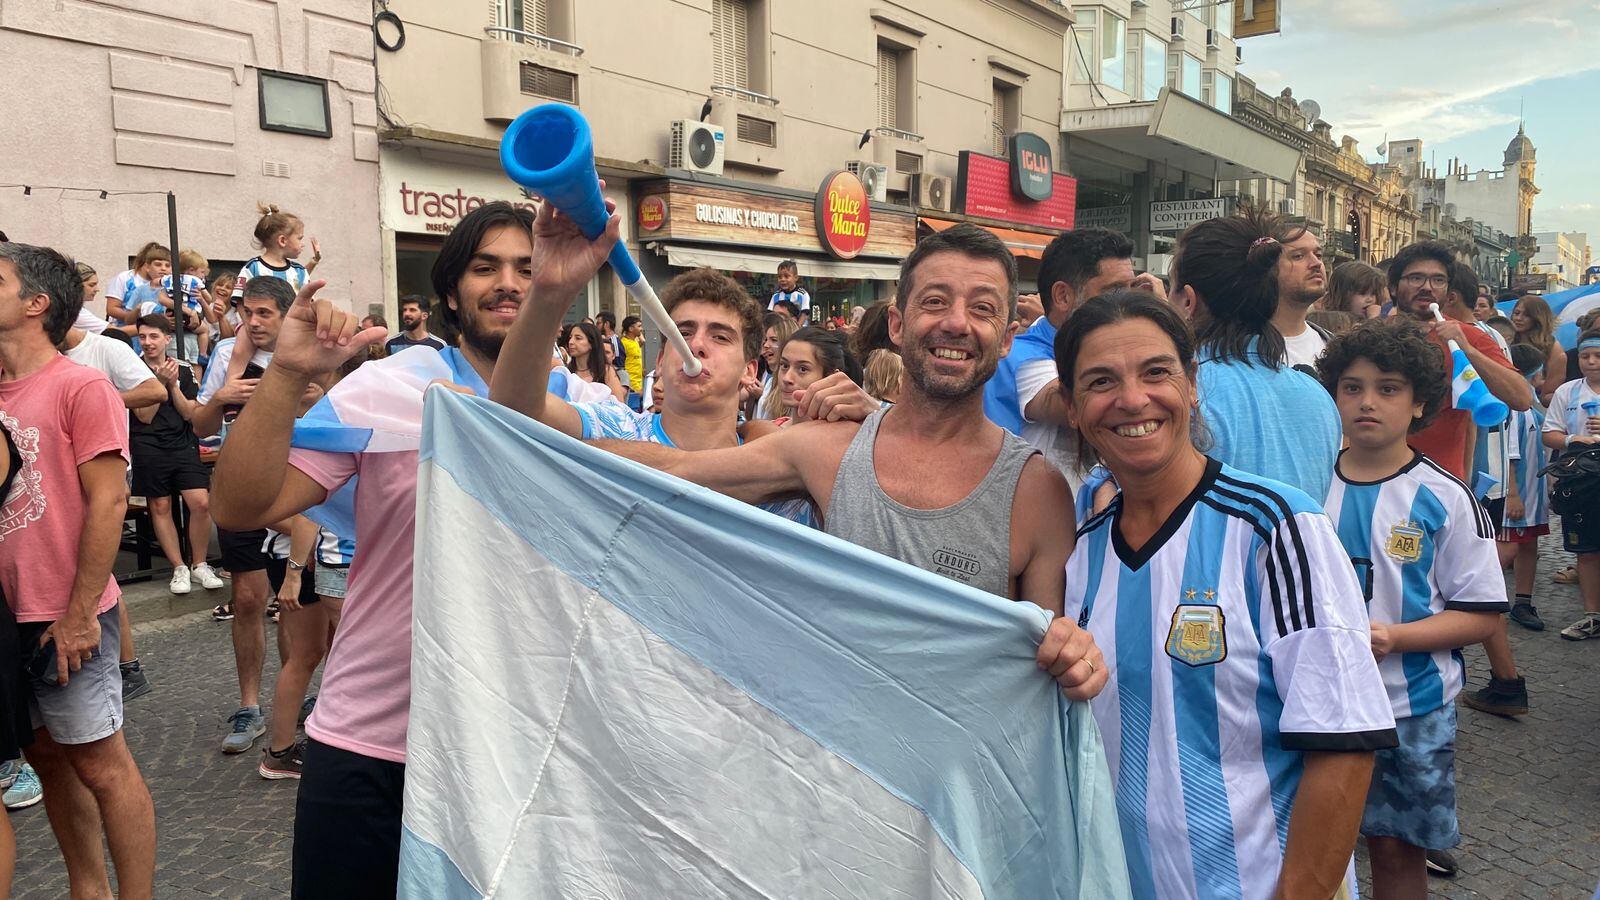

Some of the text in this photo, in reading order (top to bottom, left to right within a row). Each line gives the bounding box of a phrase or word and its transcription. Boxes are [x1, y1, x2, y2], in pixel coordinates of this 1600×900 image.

[1021, 149, 1048, 174] IGLU
[829, 191, 860, 215] Dulce
[1153, 199, 1223, 212] RESTAURANT
[696, 203, 799, 232] GOLOSINAS Y CHOCOLATES
[831, 212, 867, 237] María
[1154, 210, 1221, 223] CONFITERIA
[938, 552, 976, 573] ENDURE
